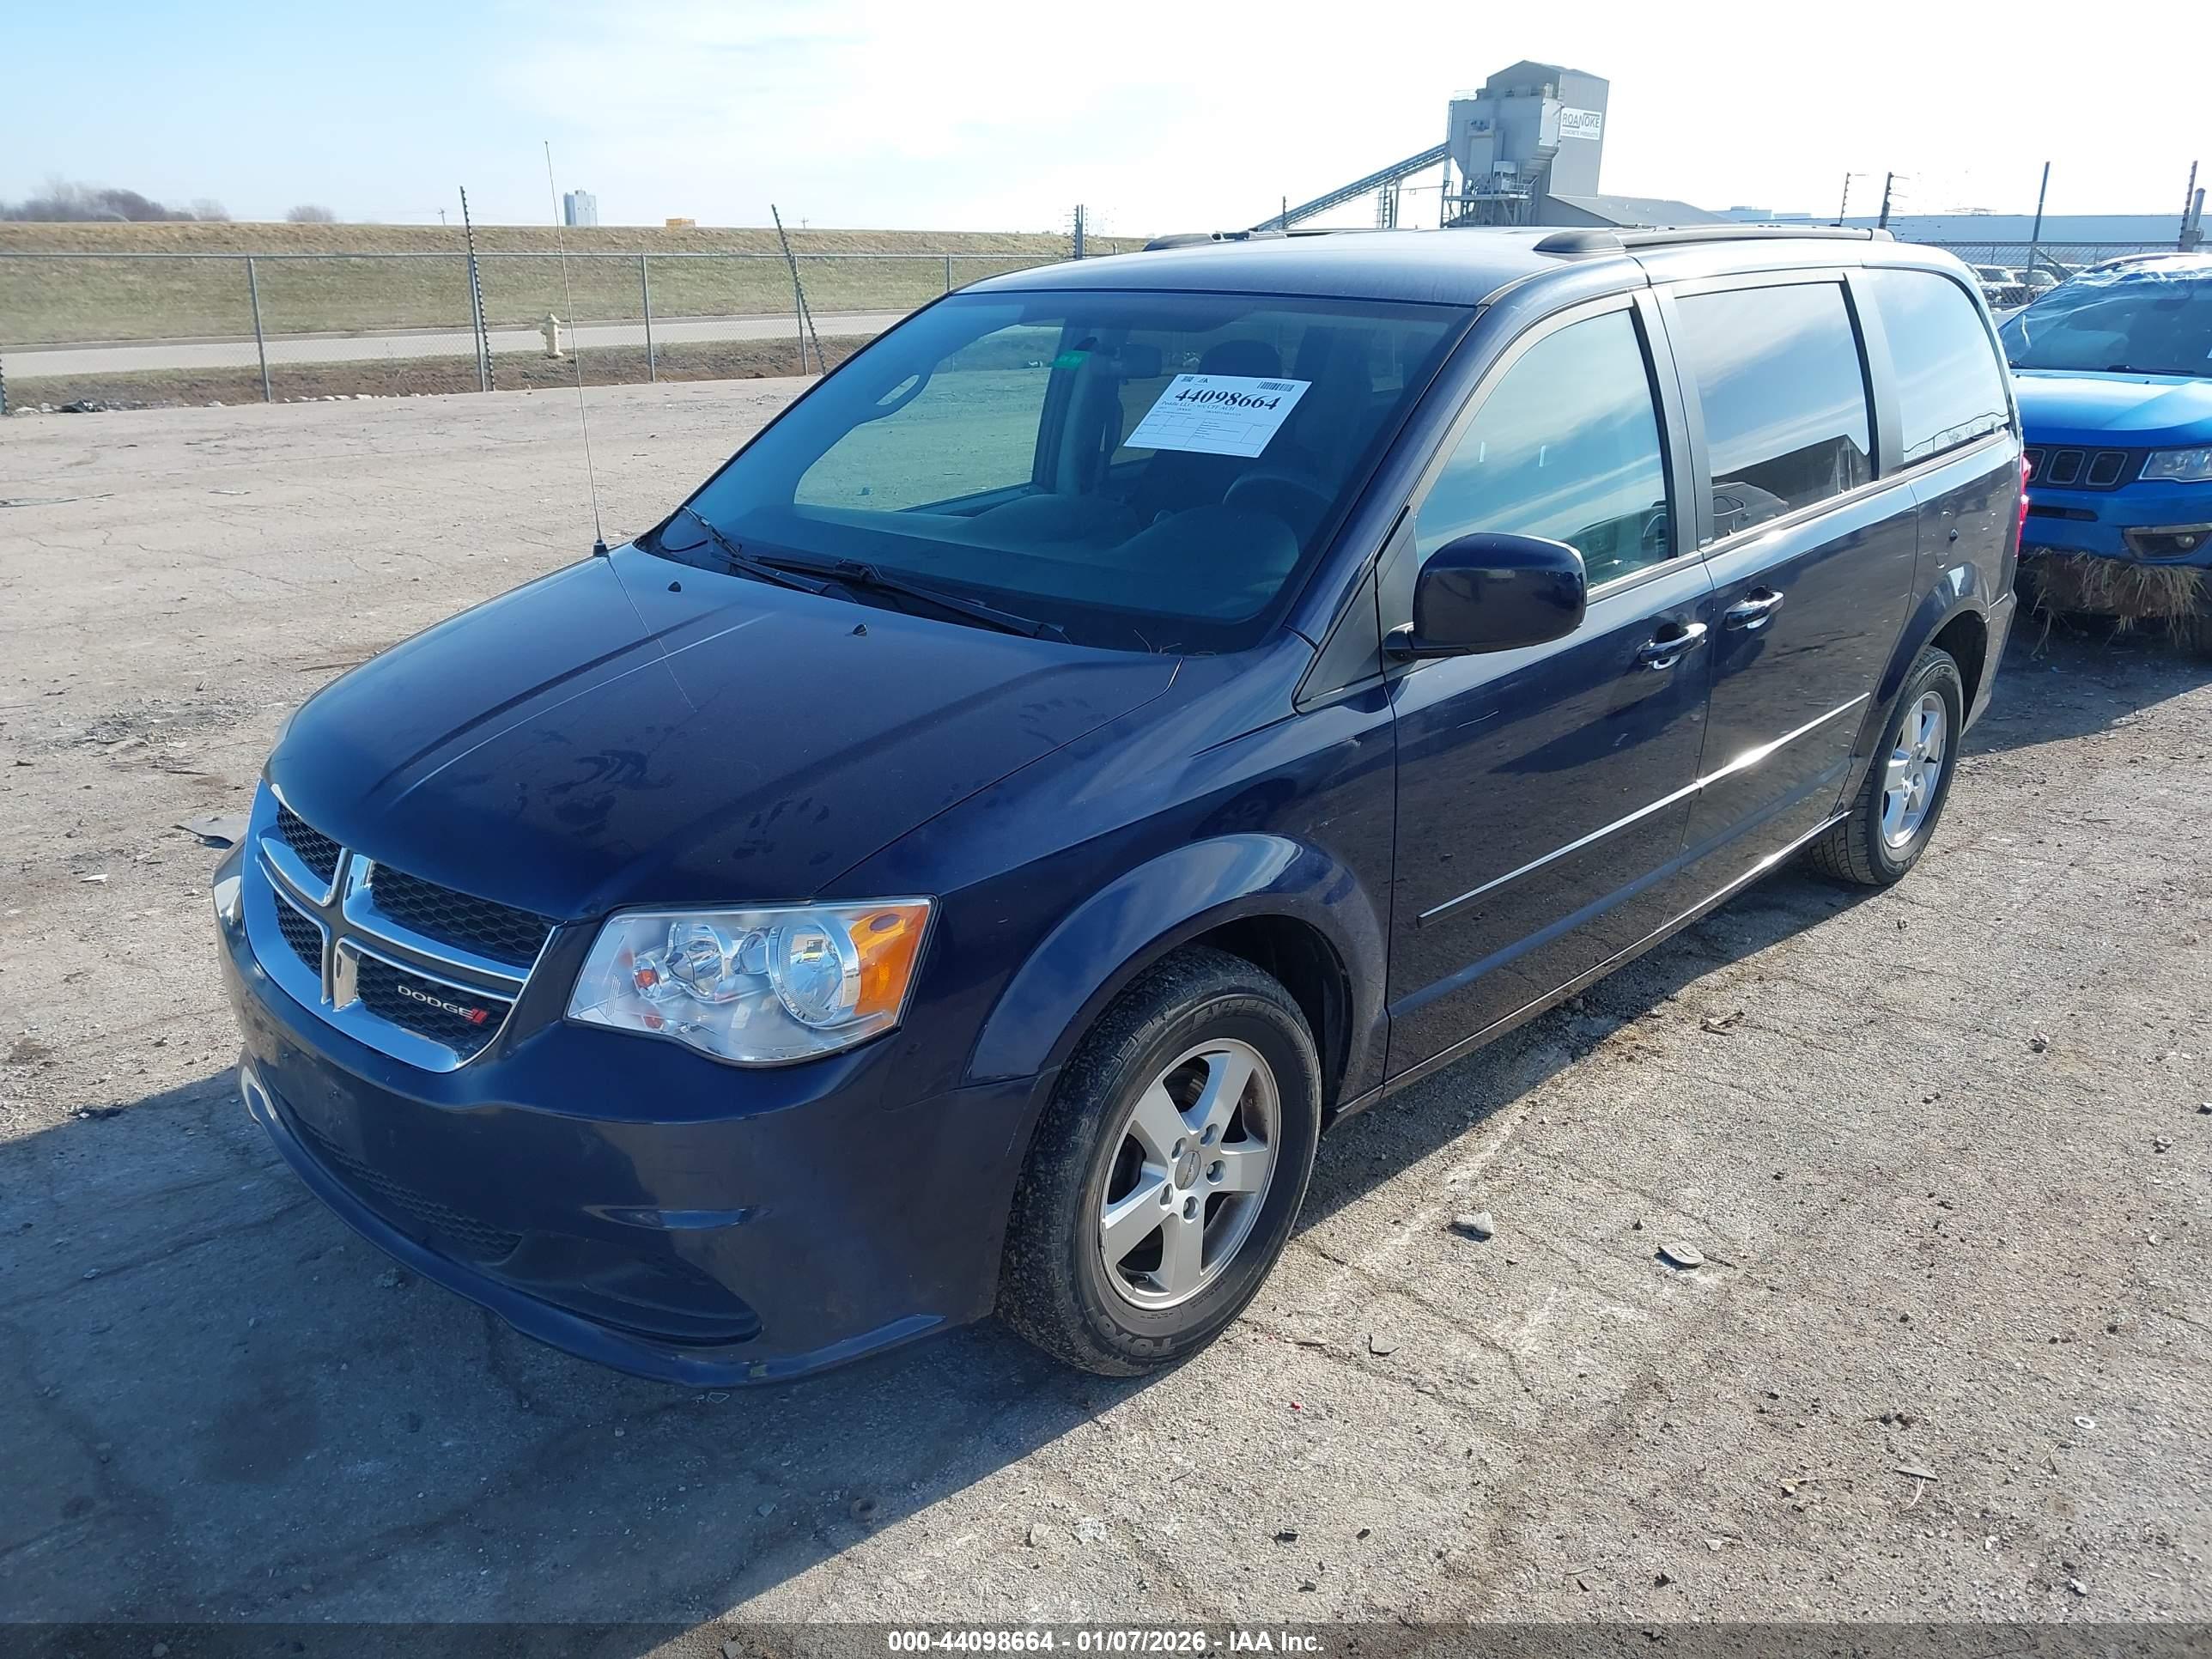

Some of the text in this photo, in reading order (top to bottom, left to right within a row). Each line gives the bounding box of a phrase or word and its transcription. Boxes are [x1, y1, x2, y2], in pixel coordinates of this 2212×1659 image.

[1562, 112, 1600, 128] ROANOKE
[1175, 389, 1282, 410] 44098664
[398, 985, 475, 1020] DODGE
